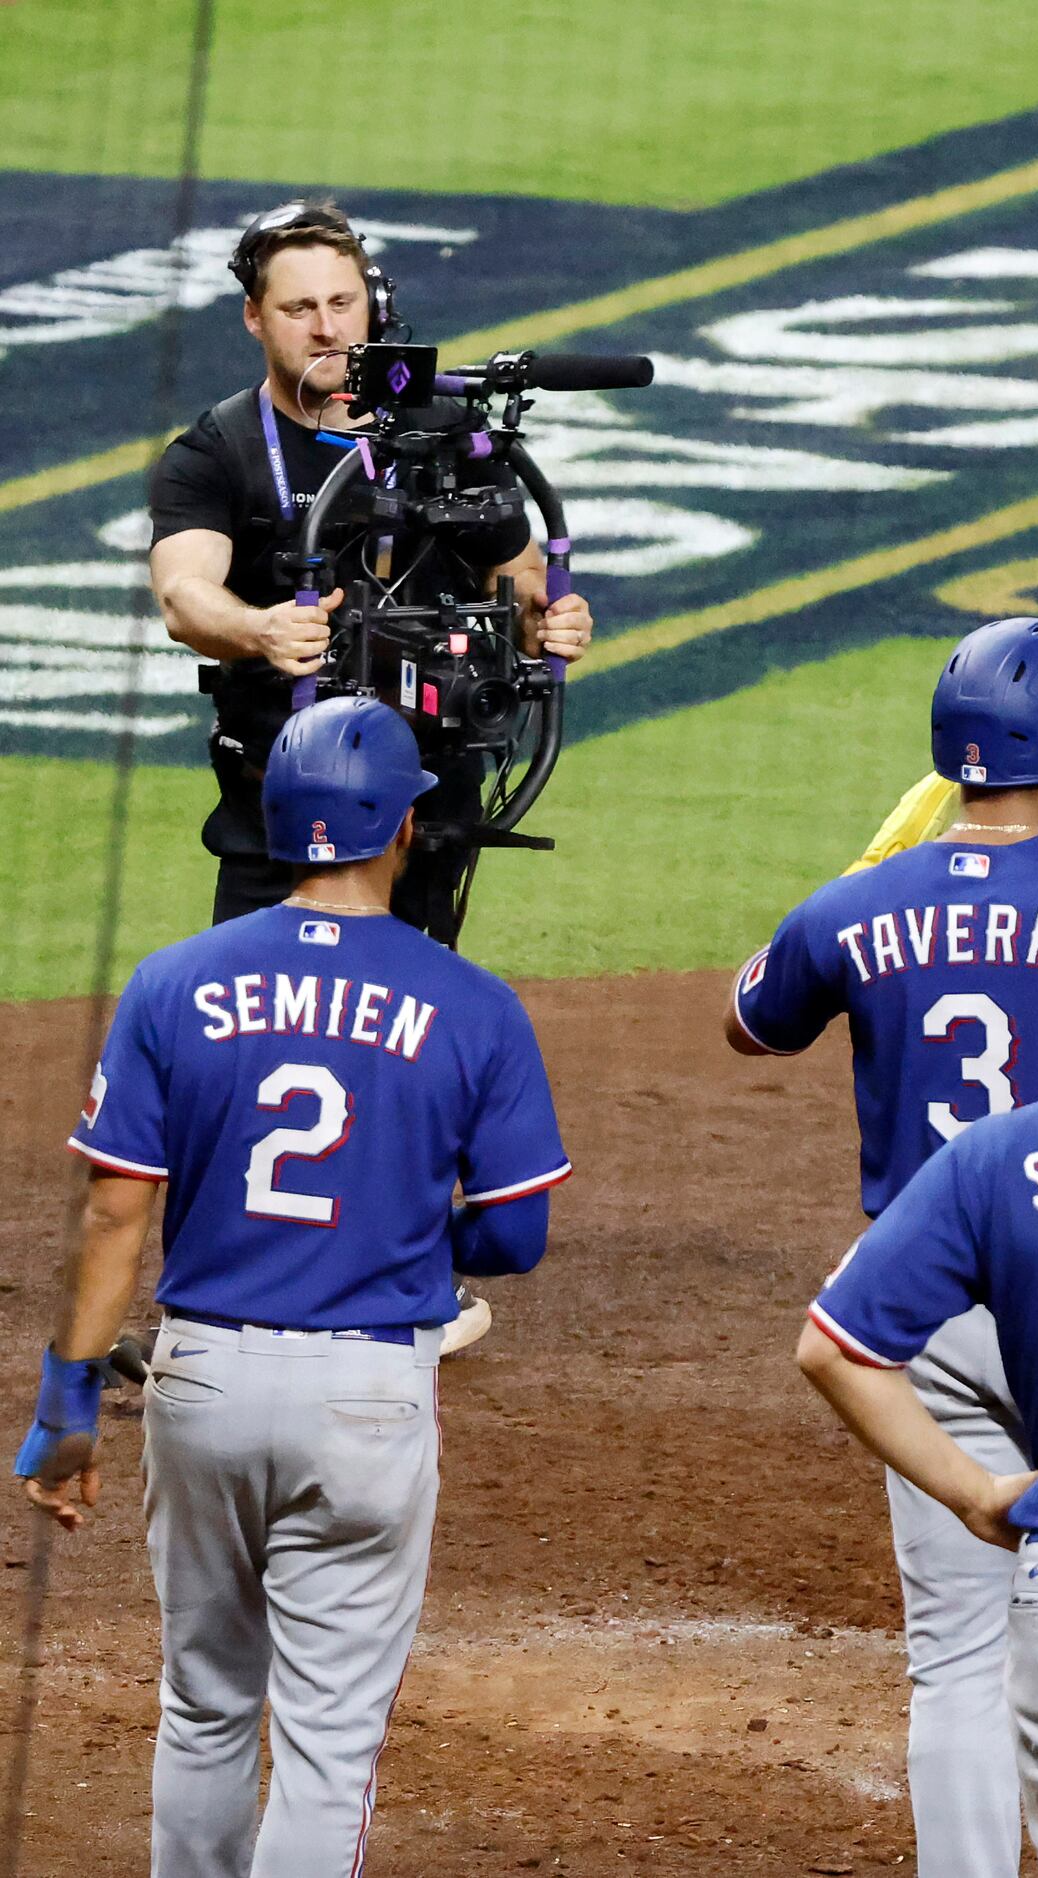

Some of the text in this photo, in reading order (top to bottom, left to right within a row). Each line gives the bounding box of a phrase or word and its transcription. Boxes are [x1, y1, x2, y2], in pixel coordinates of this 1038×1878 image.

[272, 454, 291, 508] POSTSEASON
[966, 743, 980, 764] 3
[312, 820, 327, 843] 2
[193, 972, 438, 1063] SEMIEN
[922, 993, 1021, 1140] 3
[244, 1062, 356, 1228] 2
